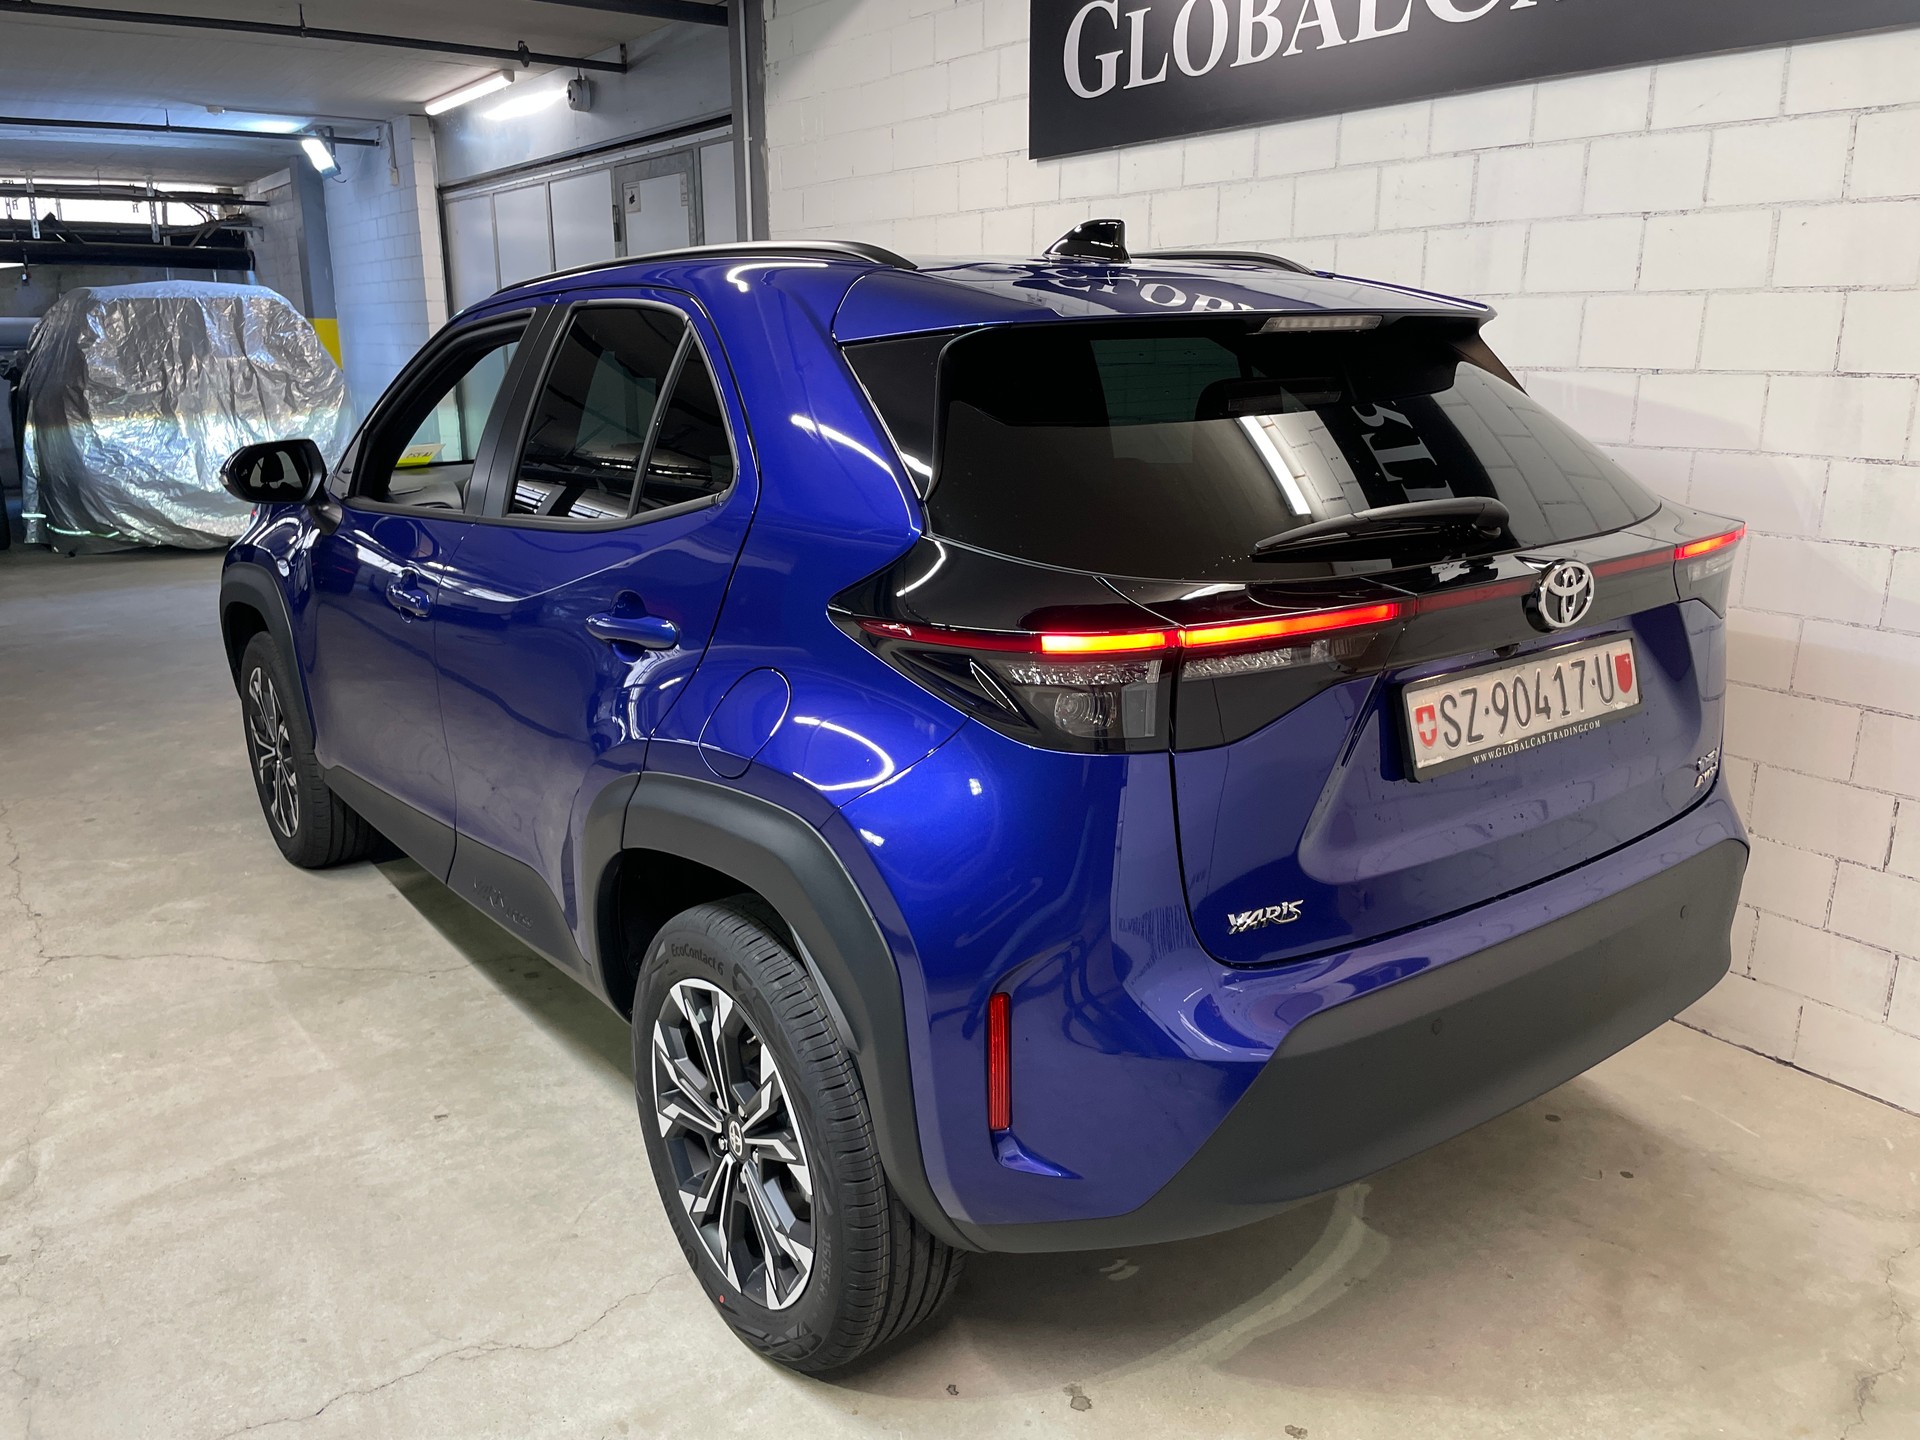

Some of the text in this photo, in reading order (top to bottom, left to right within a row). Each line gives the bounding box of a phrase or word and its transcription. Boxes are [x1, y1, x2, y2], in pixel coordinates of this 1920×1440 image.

[1063, 0, 1559, 99] GLOBAL
[1227, 899, 1304, 935] YARIS
[671, 943, 725, 976] EcoContact 6
